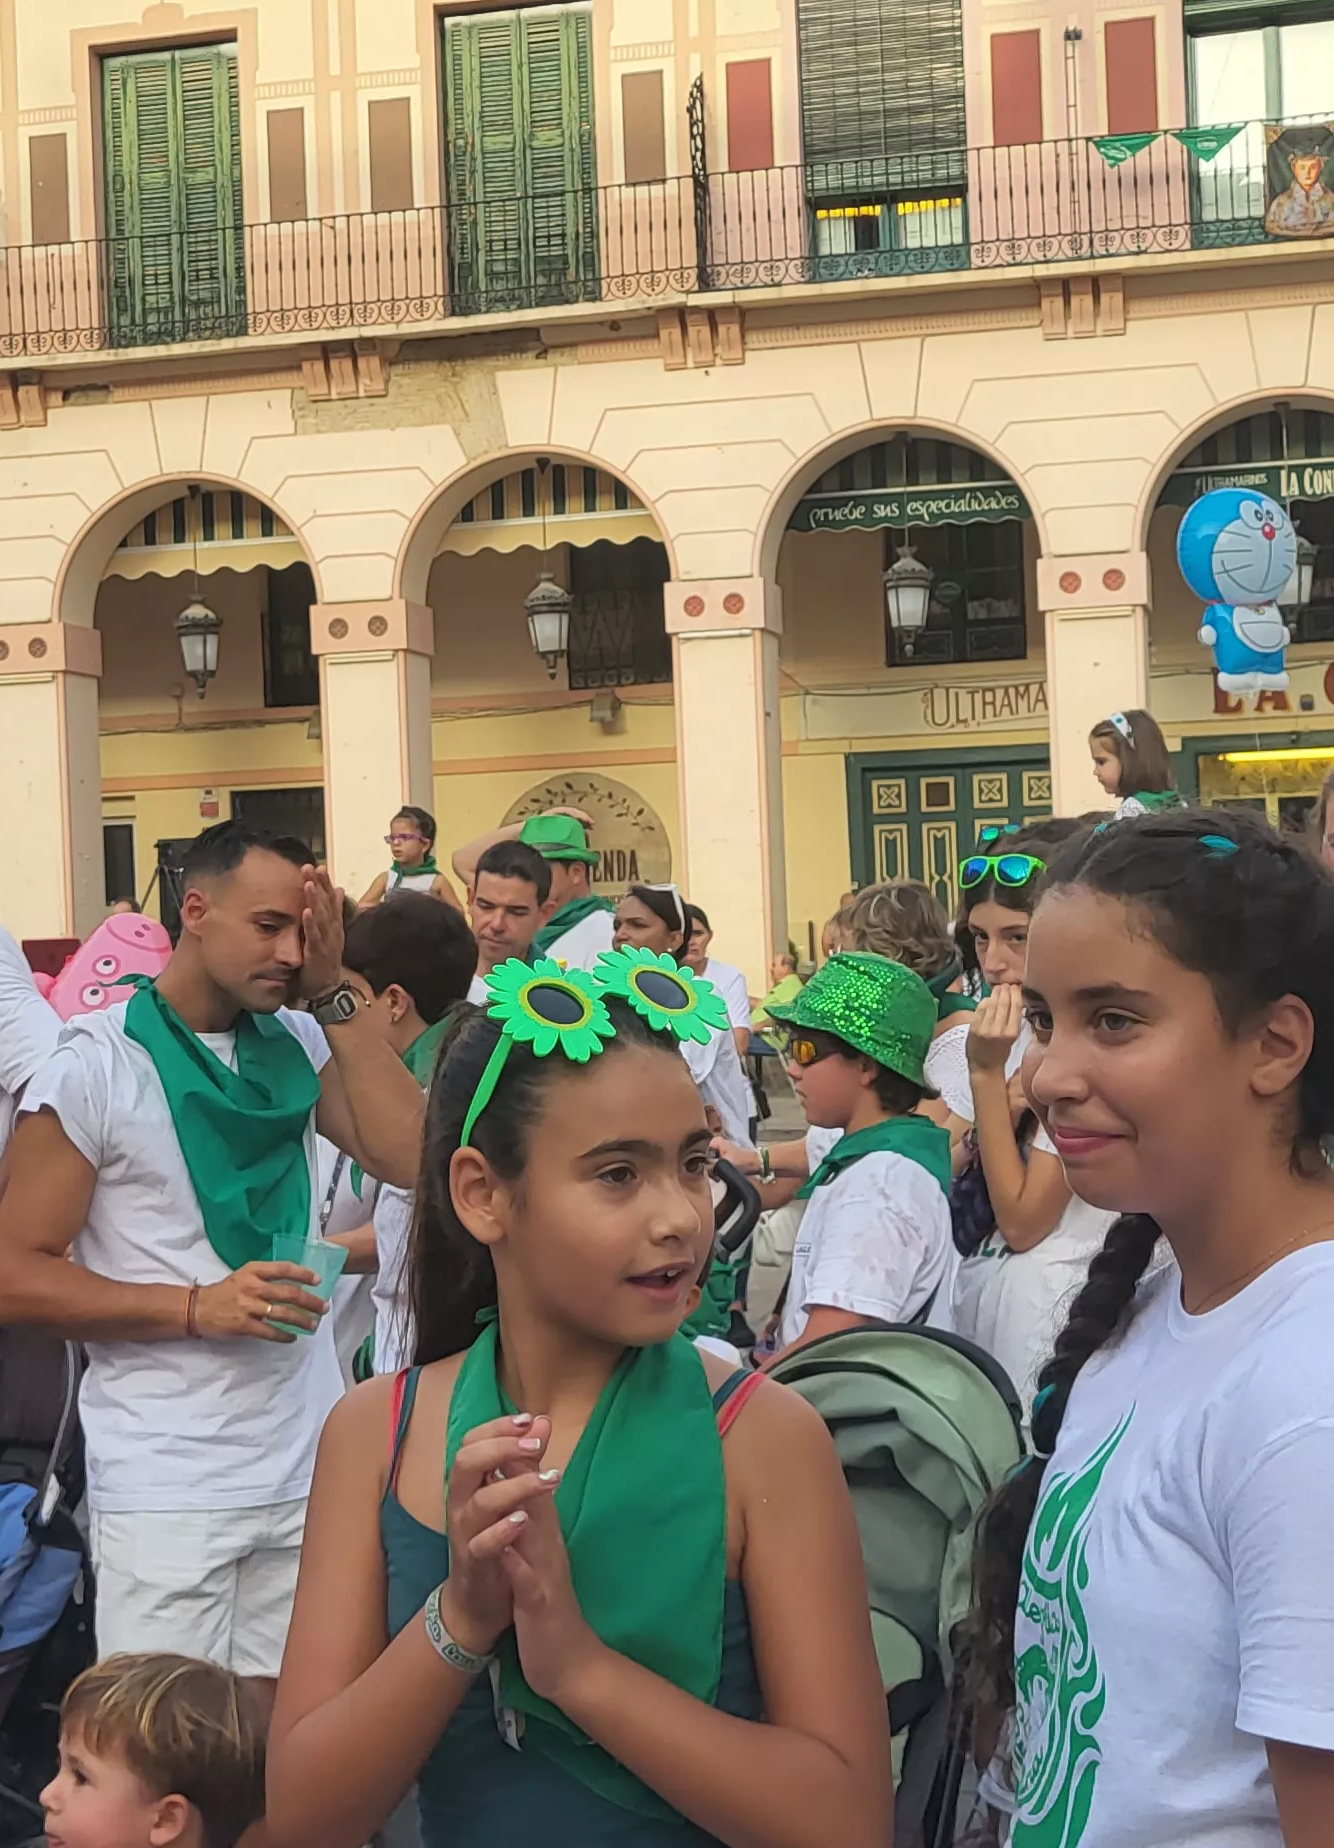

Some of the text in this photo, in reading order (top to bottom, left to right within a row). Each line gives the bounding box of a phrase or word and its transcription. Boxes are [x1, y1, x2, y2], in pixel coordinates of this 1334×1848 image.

[1280, 468, 1300, 497] LA
[809, 490, 1020, 528] pruebe sus especialidades
[930, 681, 1049, 727] ULTRAMA
[592, 849, 640, 883] ENDA
